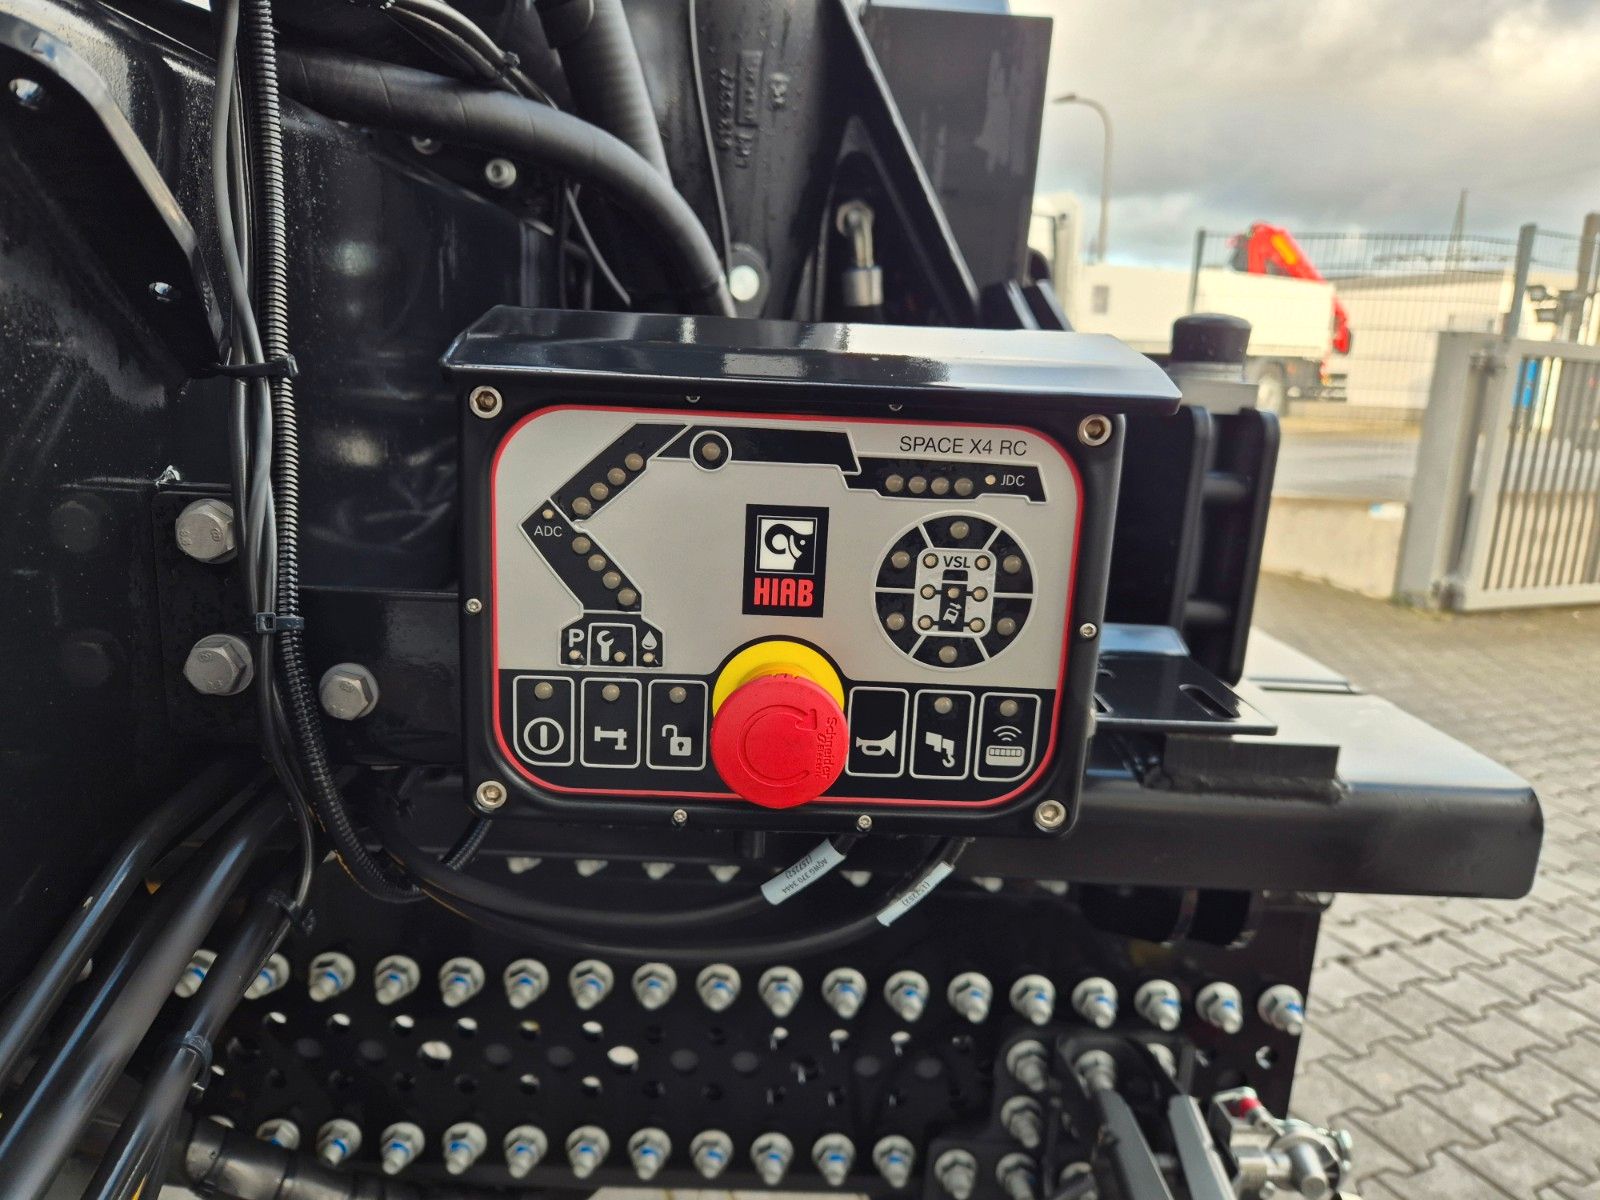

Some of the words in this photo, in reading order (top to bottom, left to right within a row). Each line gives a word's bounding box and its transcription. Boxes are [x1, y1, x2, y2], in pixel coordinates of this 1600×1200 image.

[900, 435, 965, 455] SPACE
[969, 438, 993, 454] X4
[999, 439, 1028, 456] RC
[1000, 474, 1025, 488] JDC
[533, 525, 563, 538] ADC
[942, 555, 971, 569] VSL
[753, 577, 815, 608] HIAB
[568, 629, 585, 646] P
[821, 716, 838, 779] Schneider
